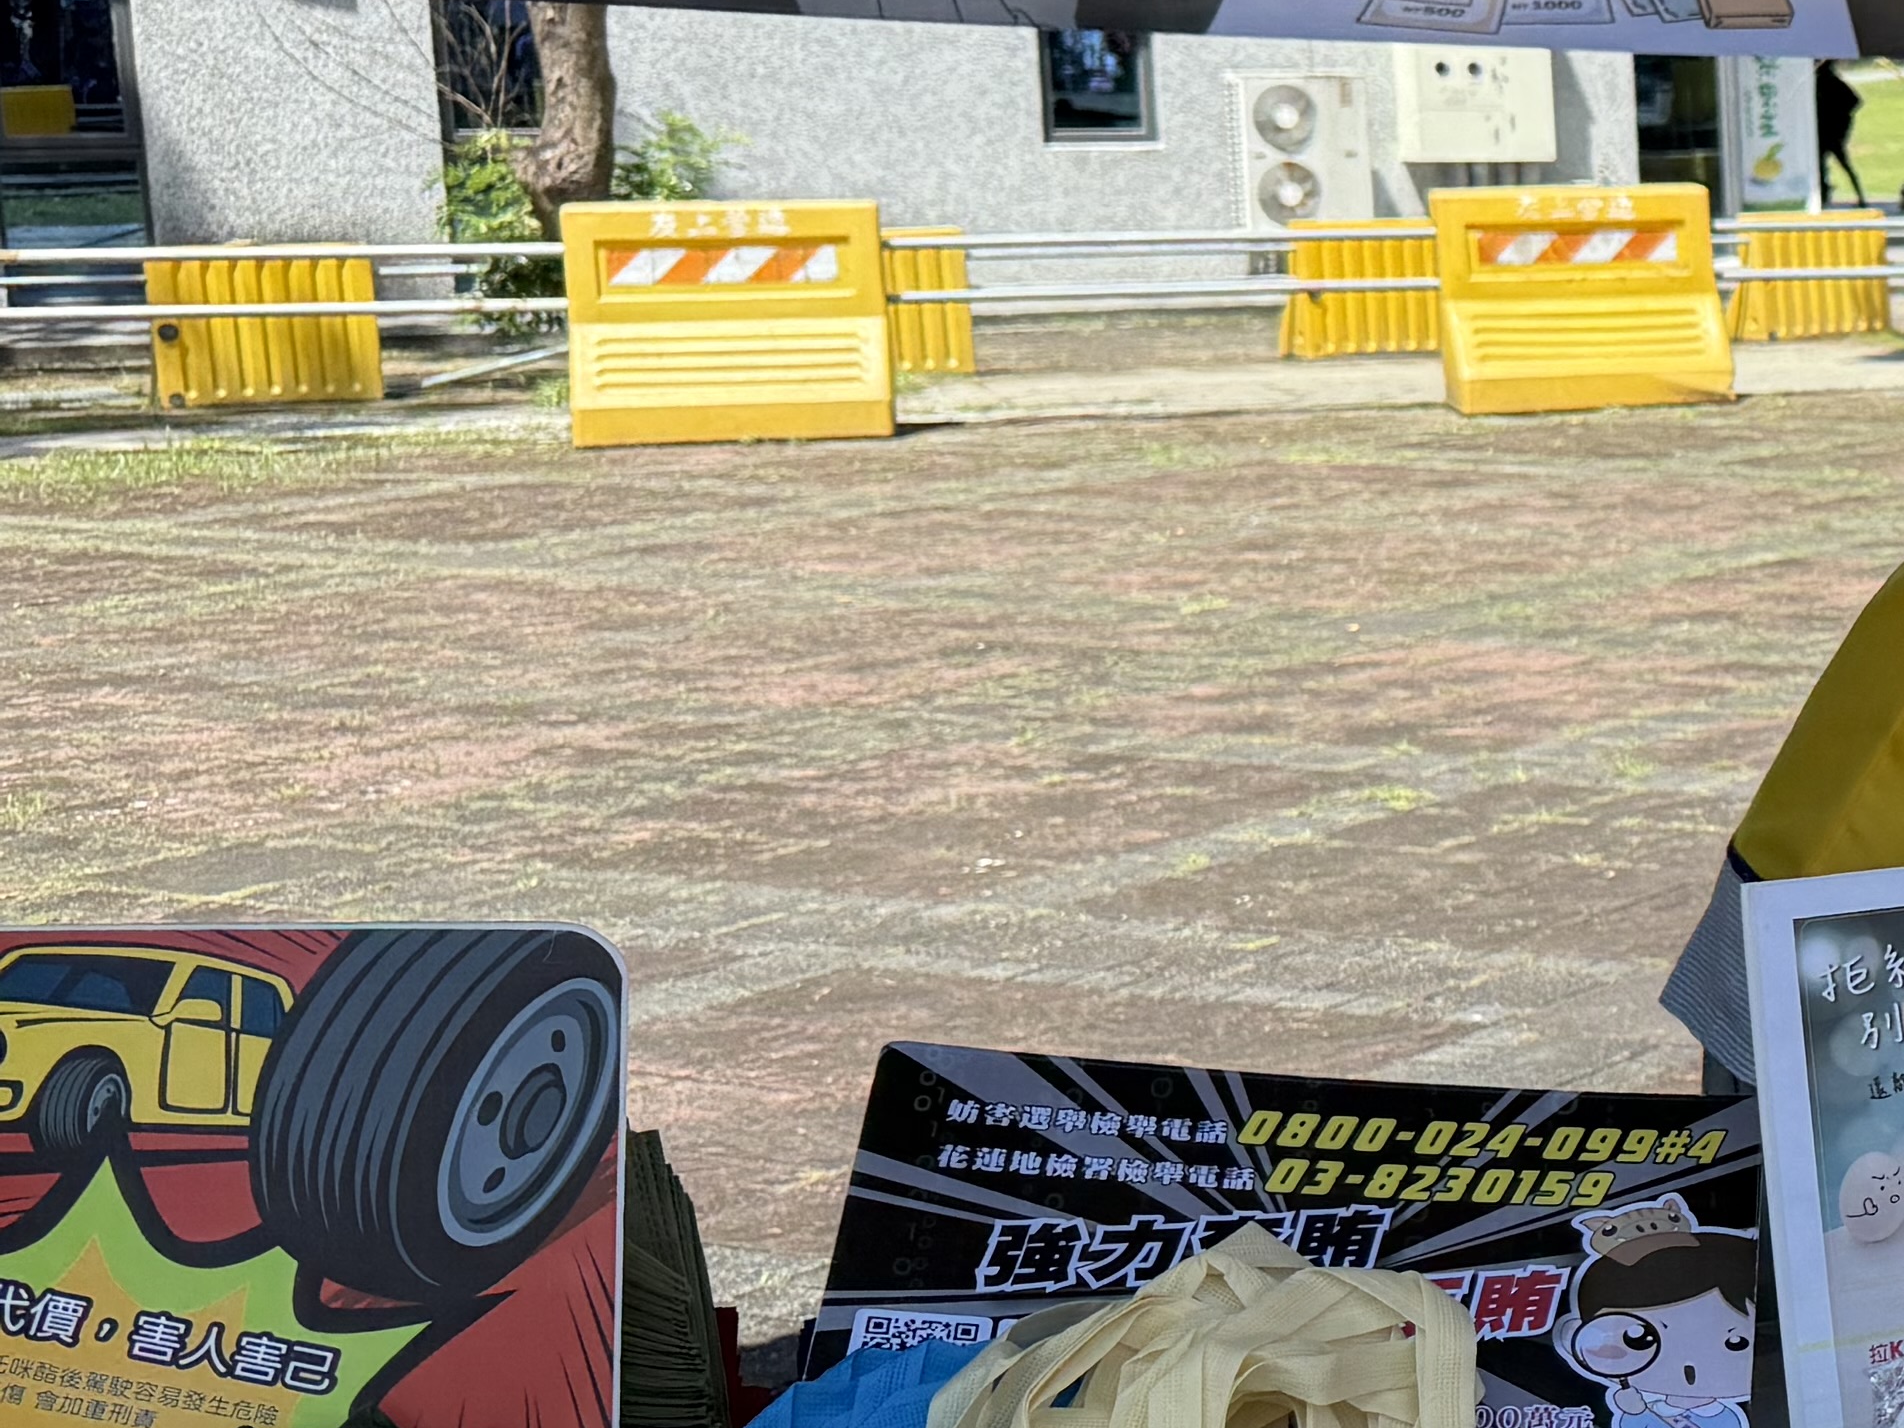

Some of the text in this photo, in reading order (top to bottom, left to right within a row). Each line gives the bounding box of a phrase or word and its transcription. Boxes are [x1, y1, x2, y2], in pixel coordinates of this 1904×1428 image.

[1237, 1109, 1727, 1165] 0800-024-099#4
[936, 1143, 1616, 1207] 花蓮地檢署檢舉電話 03-8230159
